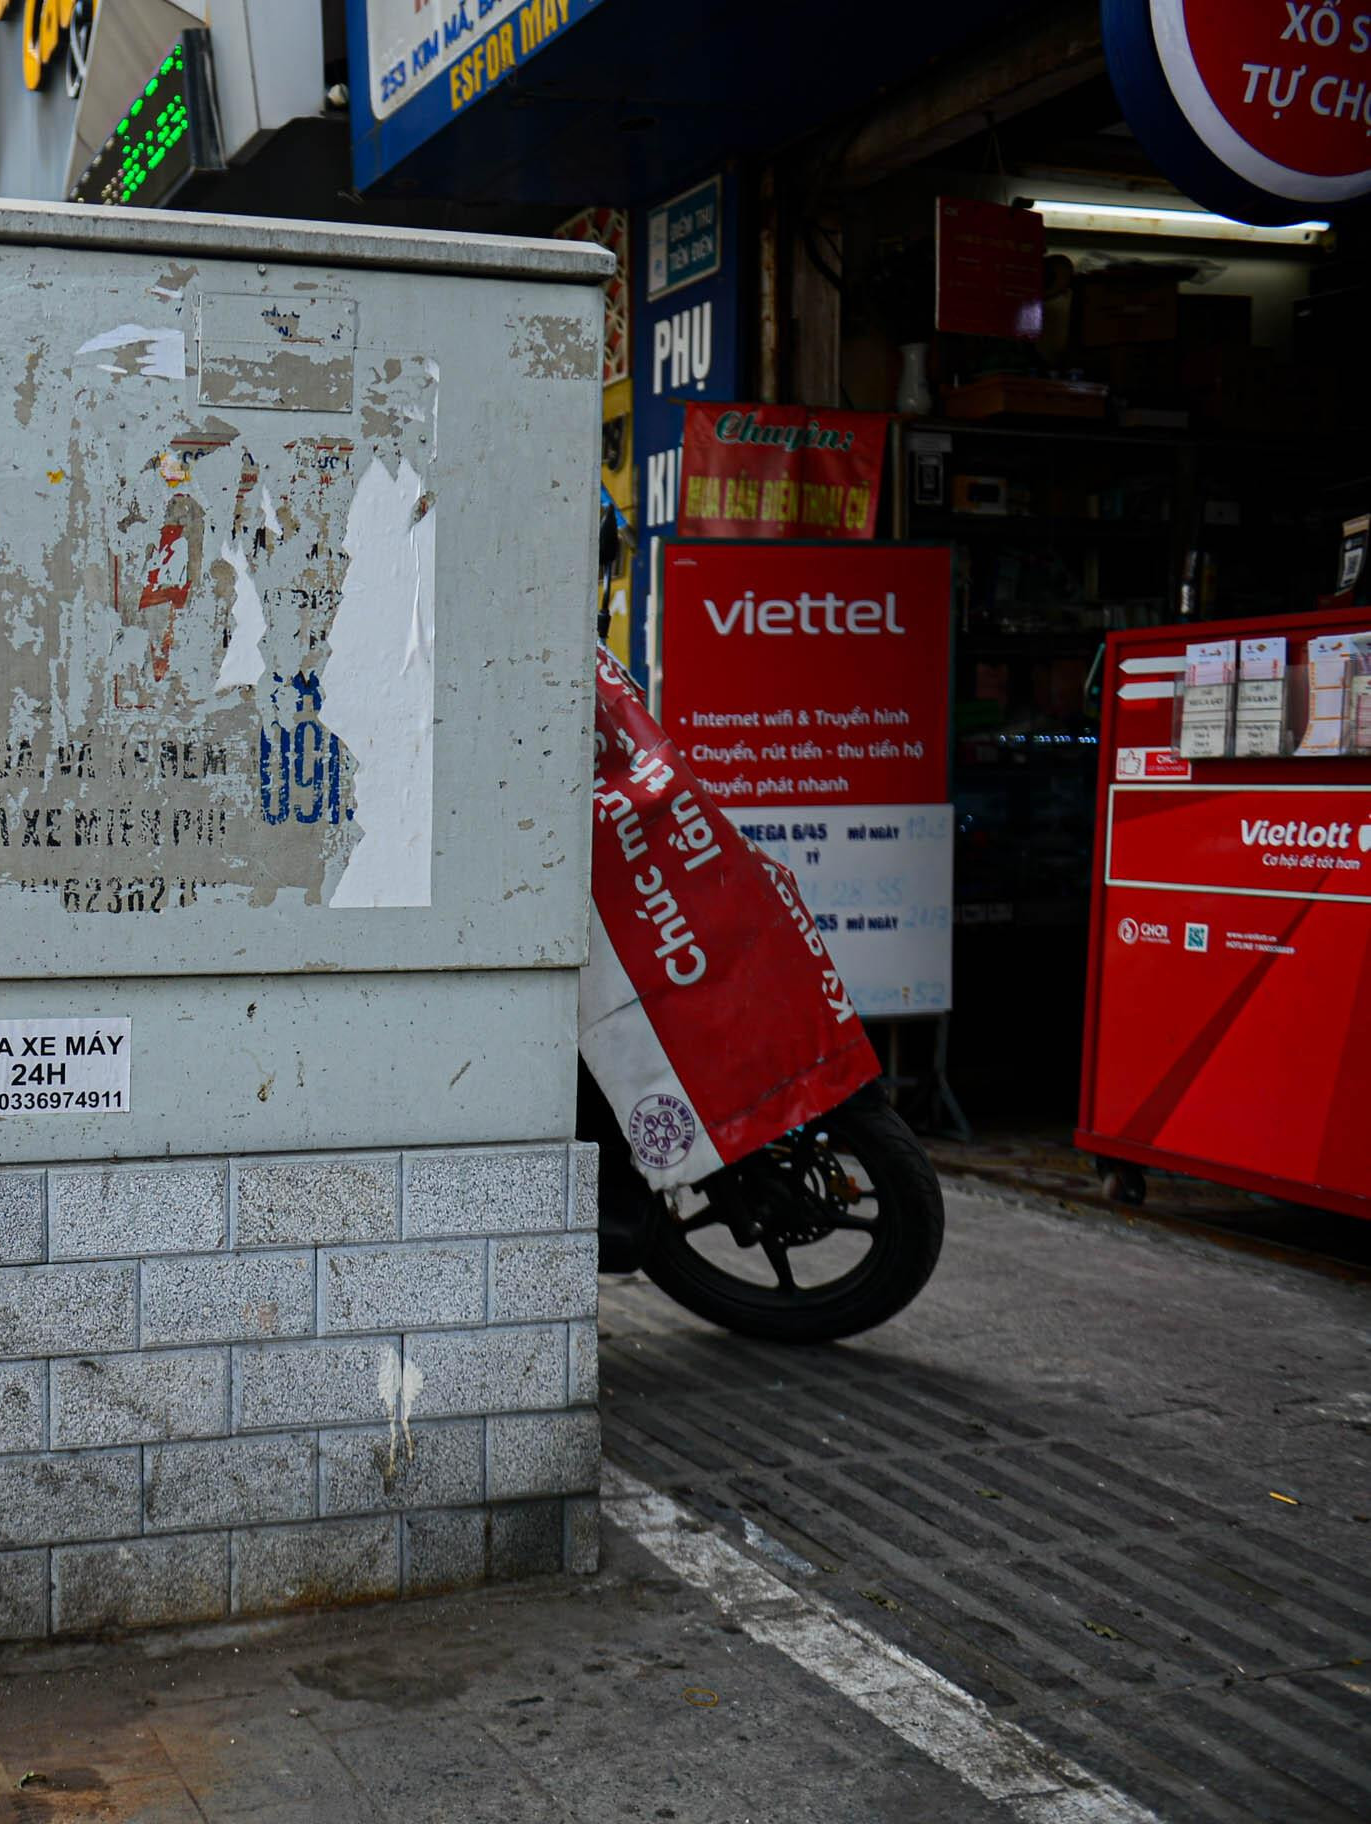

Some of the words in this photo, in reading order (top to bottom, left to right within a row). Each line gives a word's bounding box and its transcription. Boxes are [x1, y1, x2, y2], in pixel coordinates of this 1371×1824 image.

[412, 30, 439, 76] KIM
[449, 22, 516, 112] ESFOR
[1242, 63, 1307, 120] TỰ
[653, 301, 712, 394] PHỤ
[647, 446, 683, 527] KI
[704, 590, 906, 636] viettel
[693, 711, 759, 727] Internet
[764, 710, 793, 727] wifi
[798, 711, 810, 726] &
[815, 706, 870, 730] Truyền
[874, 707, 910, 726] hình
[761, 742, 787, 760] rút
[790, 739, 822, 759] tiền
[837, 742, 864, 759] thu
[868, 738, 900, 758] tiền
[696, 774, 753, 799] huyển
[757, 775, 793, 797] phát
[798, 776, 849, 793] nhanh
[668, 789, 723, 871] lần
[740, 824, 787, 841] MEGA
[792, 824, 827, 840] 6/45
[1241, 819, 1353, 849] Vietlott
[635, 865, 707, 986] Chúc
[21, 1036, 56, 1057] XE
[66, 1030, 124, 1056] MÁY
[11, 1063, 66, 1086] 24H
